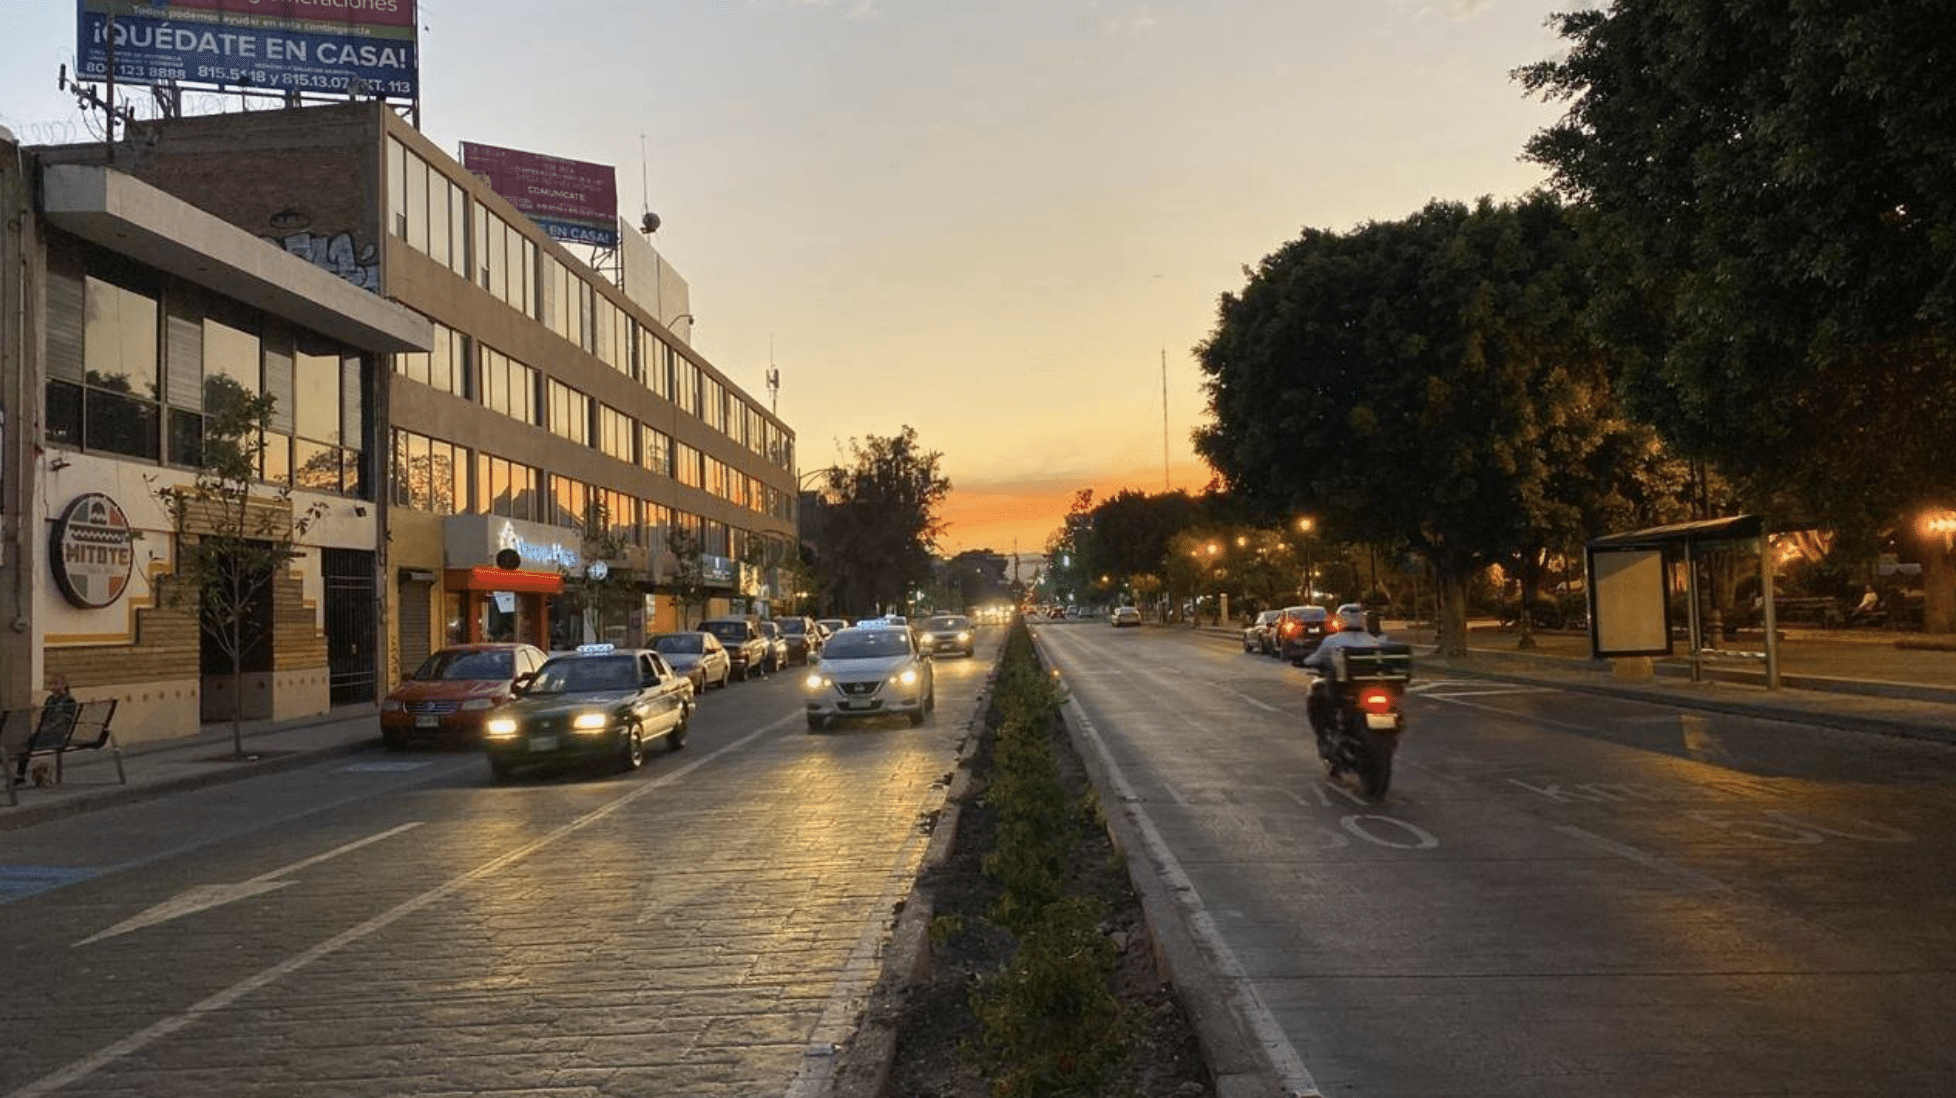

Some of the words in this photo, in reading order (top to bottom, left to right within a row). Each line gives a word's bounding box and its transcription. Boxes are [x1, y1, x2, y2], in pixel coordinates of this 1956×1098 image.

[93, 21, 256, 57] ¡QUÉDATE
[266, 37, 307, 62] EN
[316, 42, 406, 69] CASA!
[120, 64, 144, 76] 123
[549, 224, 568, 238] EN
[66, 542, 129, 566] MITOTE
